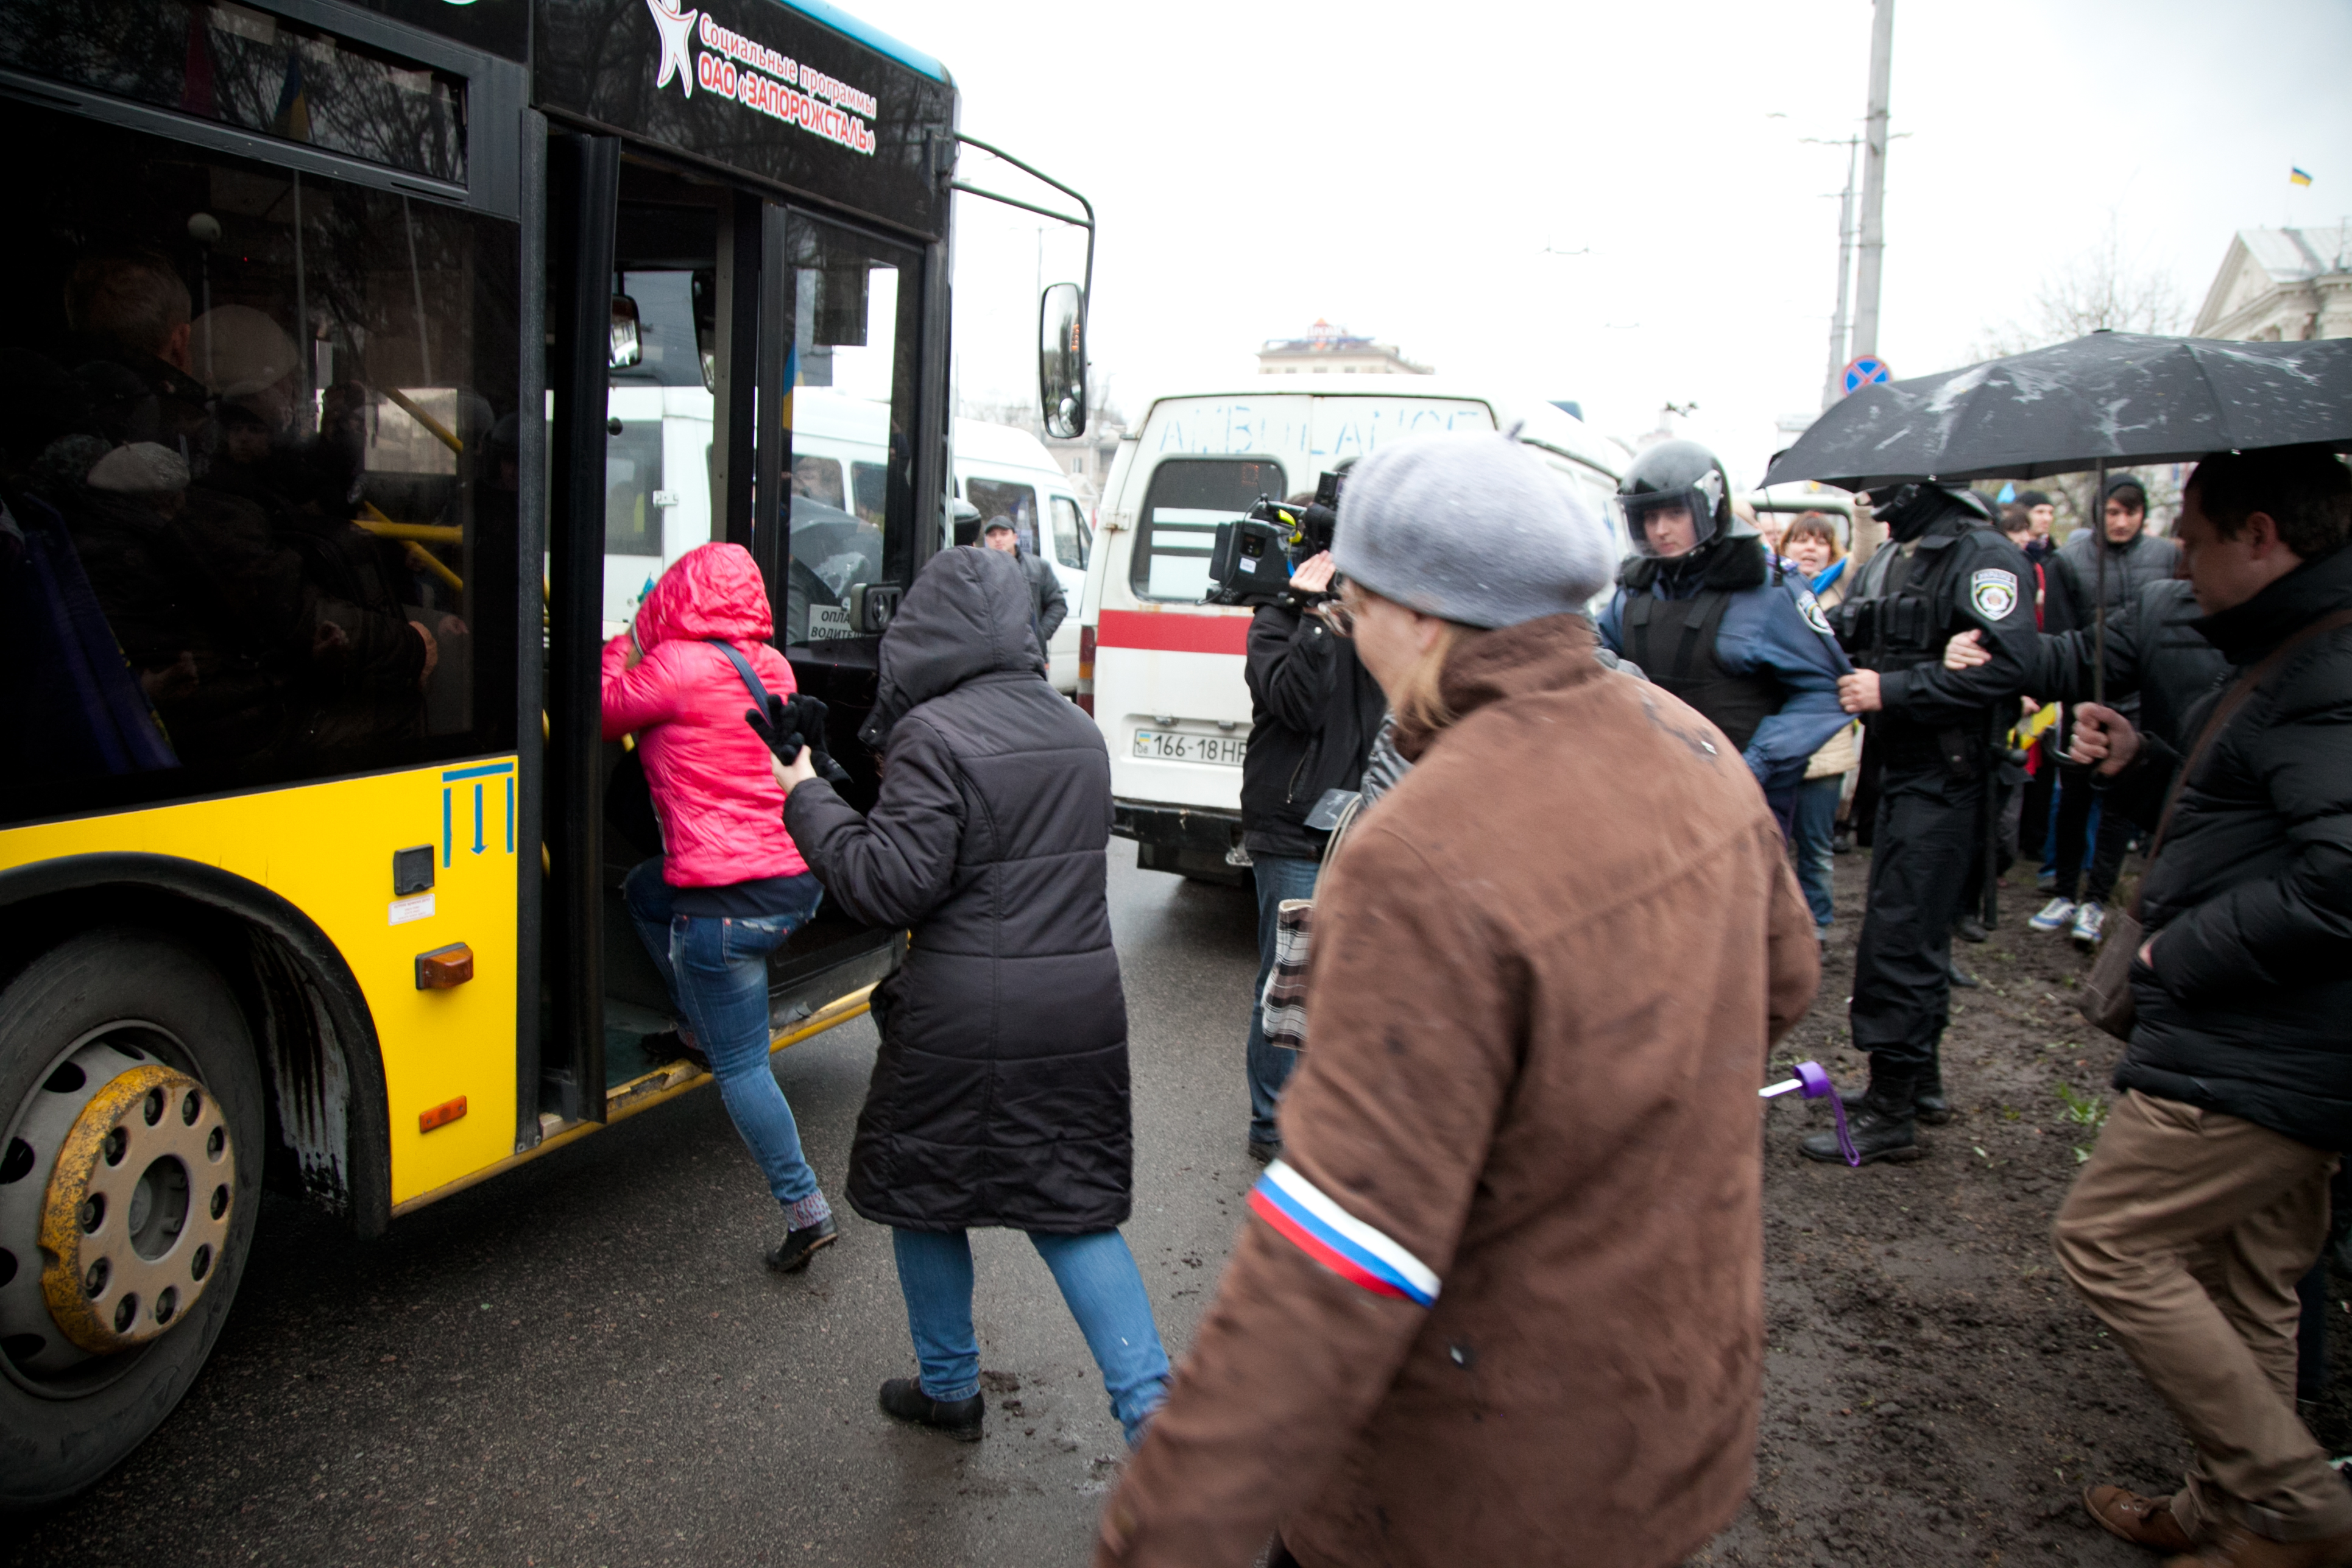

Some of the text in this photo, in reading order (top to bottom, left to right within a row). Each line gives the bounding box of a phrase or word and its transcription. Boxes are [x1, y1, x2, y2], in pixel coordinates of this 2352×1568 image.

[699, 52, 875, 155] ОАО «ЗАПОРОЖСТАЛЬ»
[701, 13, 877, 119] Социальные программы
